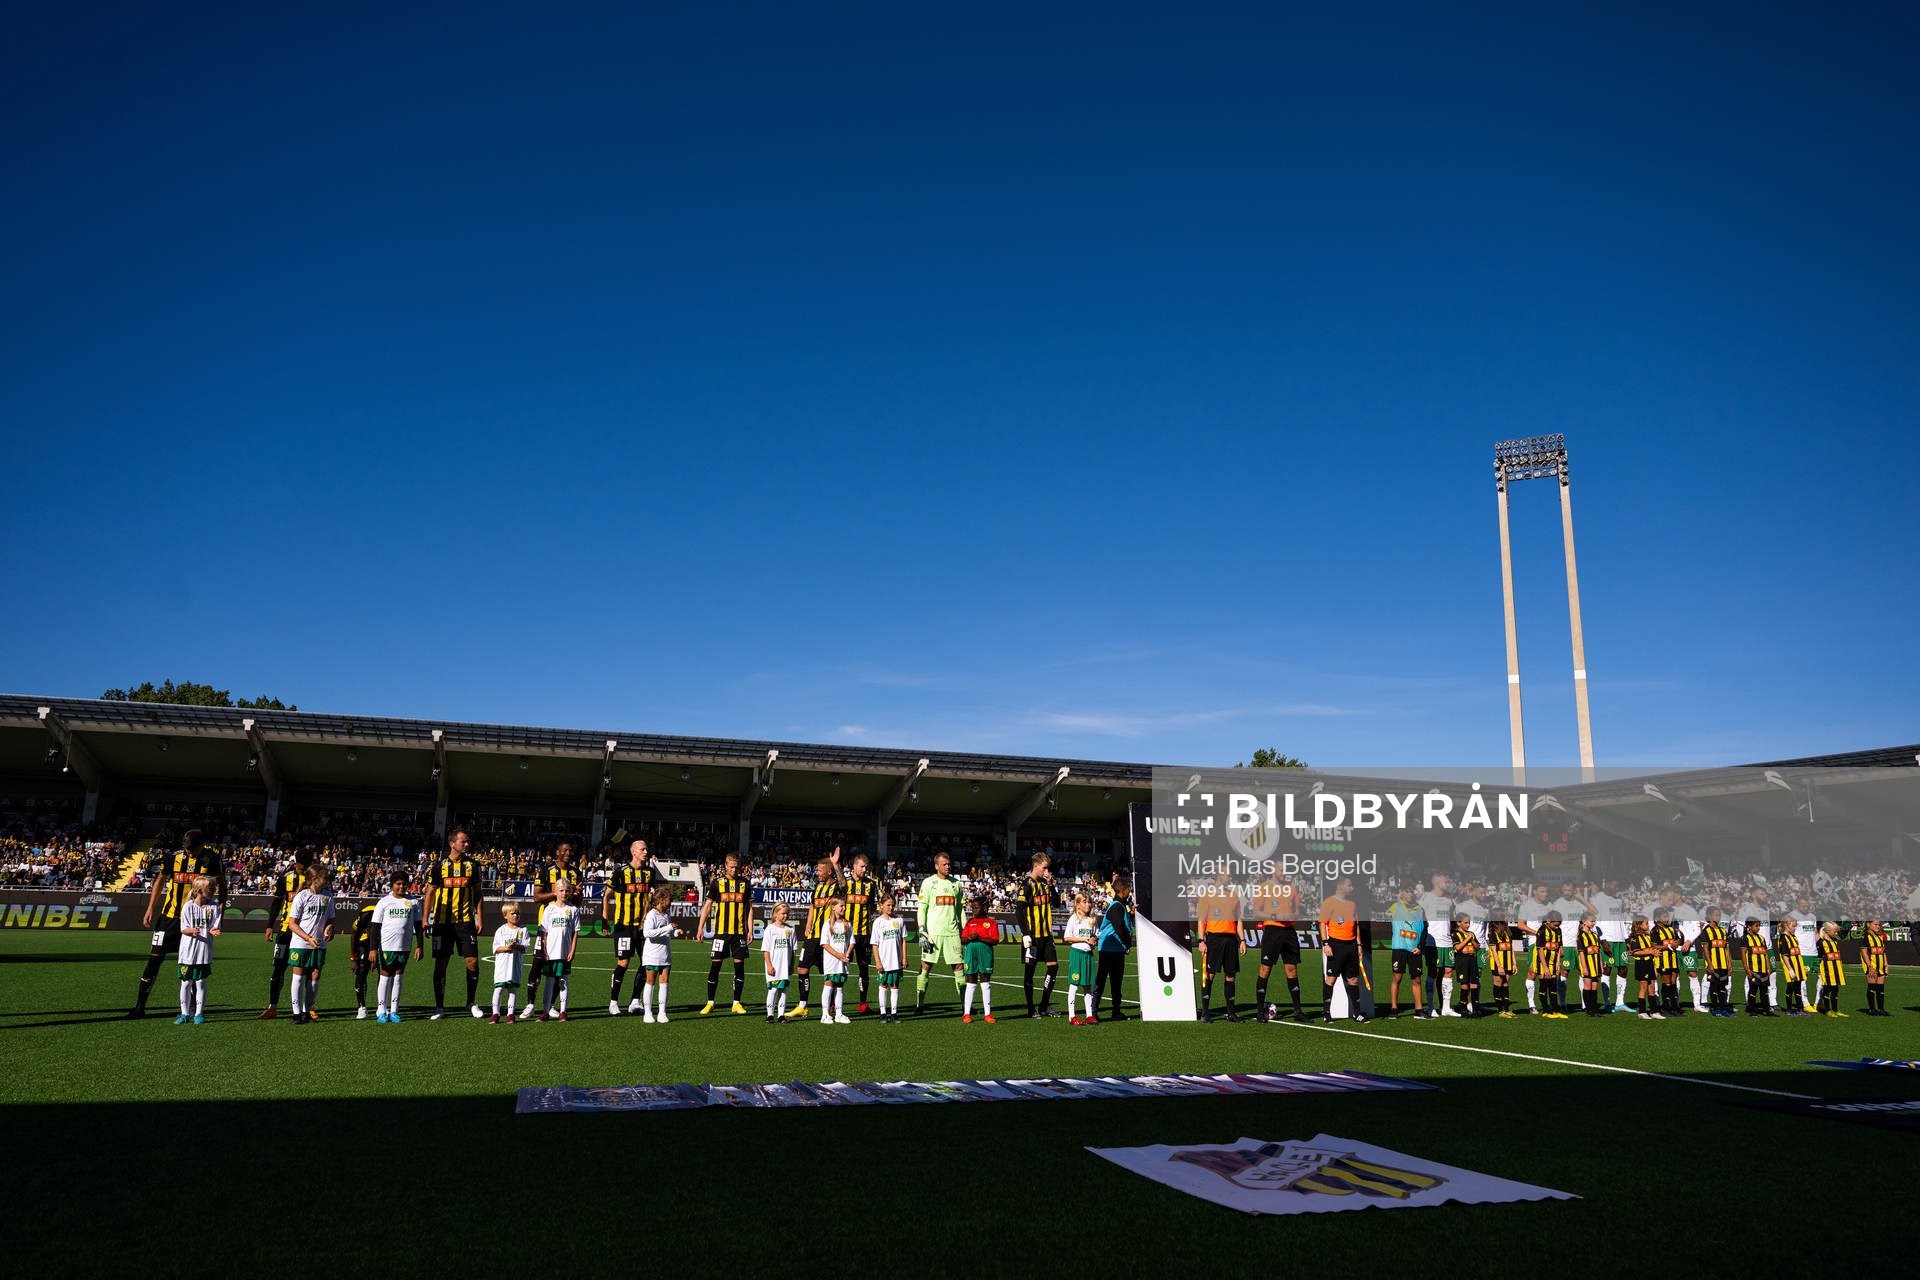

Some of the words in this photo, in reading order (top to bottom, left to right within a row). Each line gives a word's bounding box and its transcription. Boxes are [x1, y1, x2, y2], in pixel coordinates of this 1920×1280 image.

[1146, 816, 1212, 837] UNIBET
[763, 890, 813, 904] ALLSVENSK
[1157, 956, 1176, 983] U
